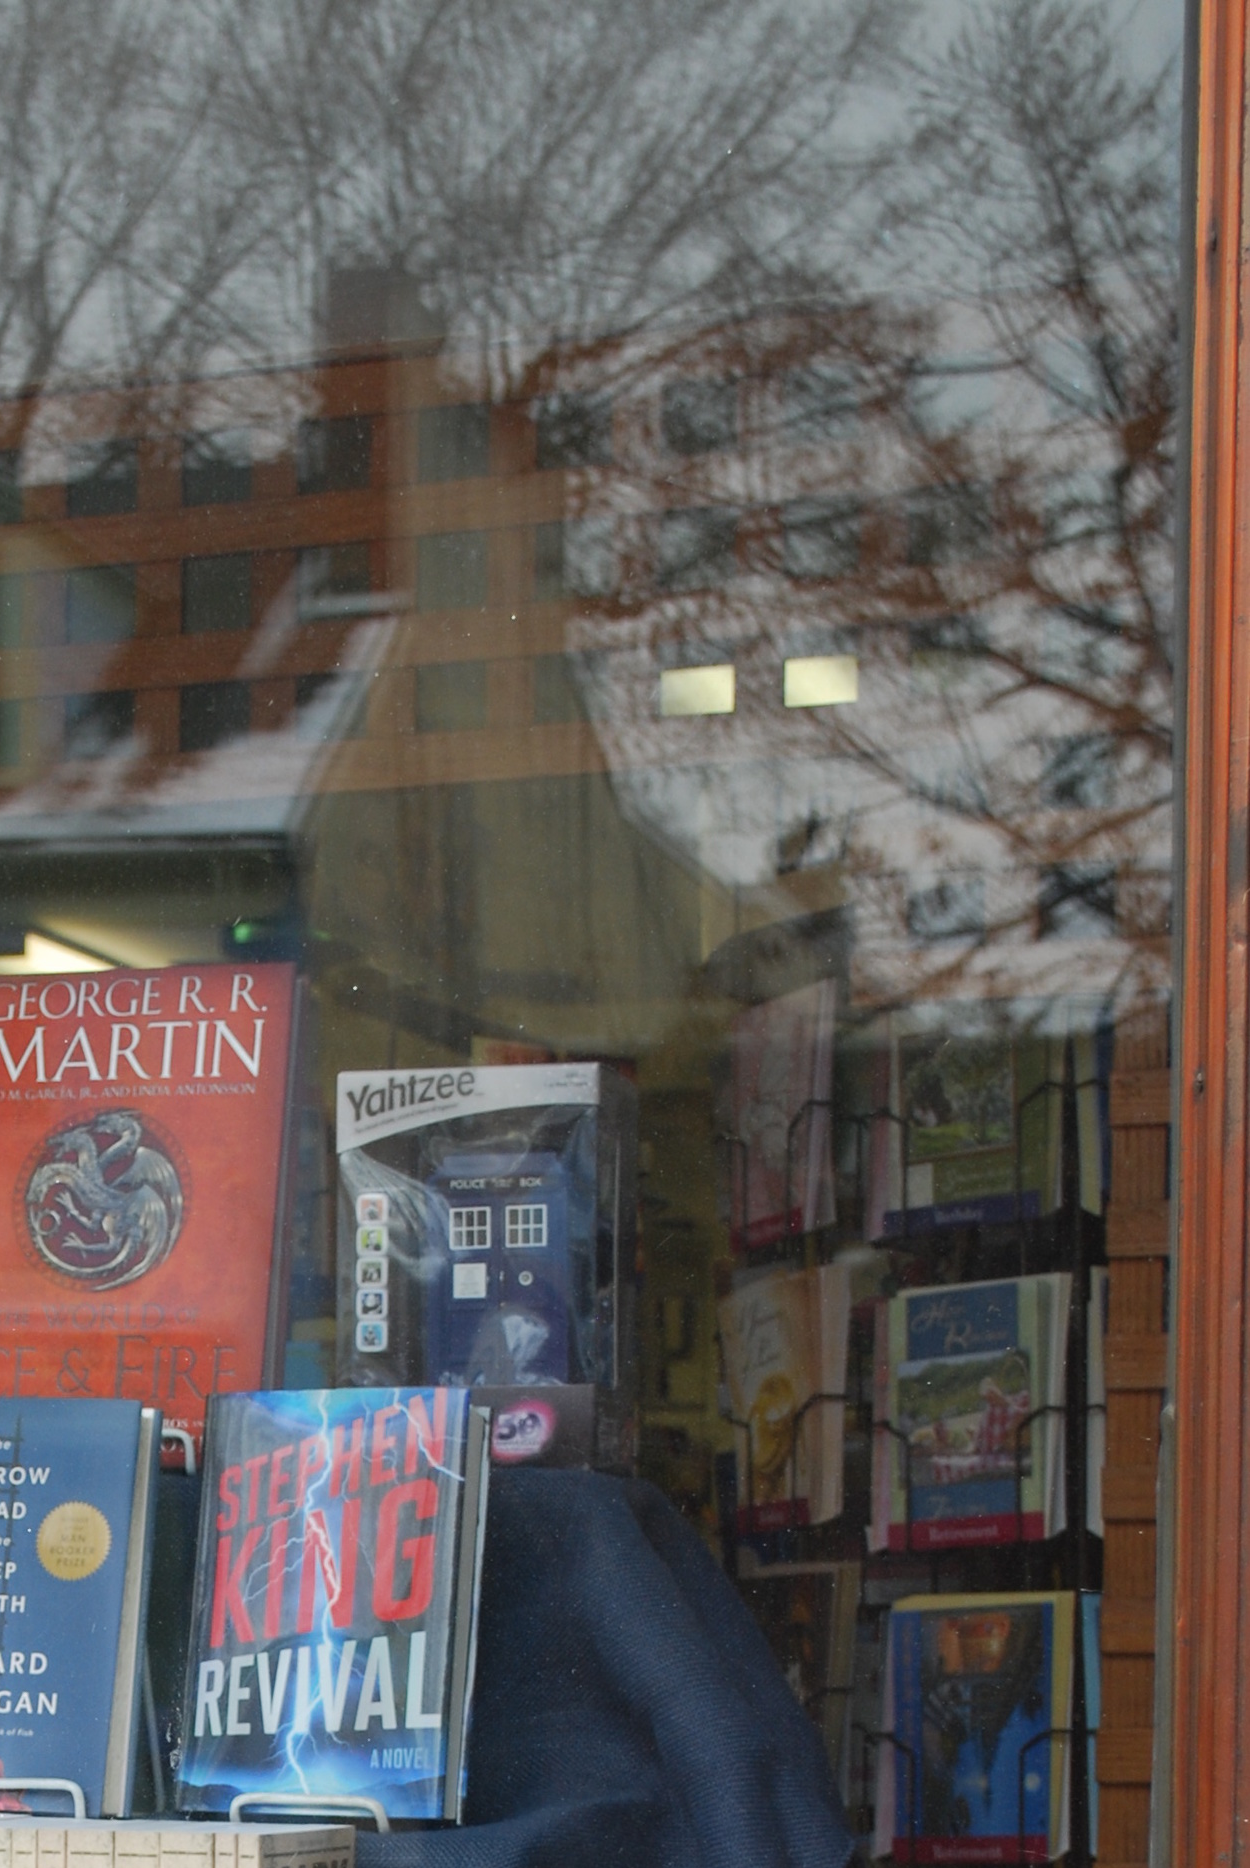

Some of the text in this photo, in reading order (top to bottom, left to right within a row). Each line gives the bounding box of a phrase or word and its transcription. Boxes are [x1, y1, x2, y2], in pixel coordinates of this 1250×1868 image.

[178, 975, 215, 1013] R.
[230, 973, 268, 1012] R.
[346, 1071, 476, 1122] Yahtzee
[450, 1176, 542, 1190] POLICE BOX
[55, 1348, 93, 1394] &
[112, 1333, 238, 1400] FIRE
[216, 1388, 448, 1532] STEPHEN
[209, 1478, 440, 1649] KING
[194, 1630, 443, 1738] REVIVAL
[369, 1746, 433, 1770] A NOVEL
